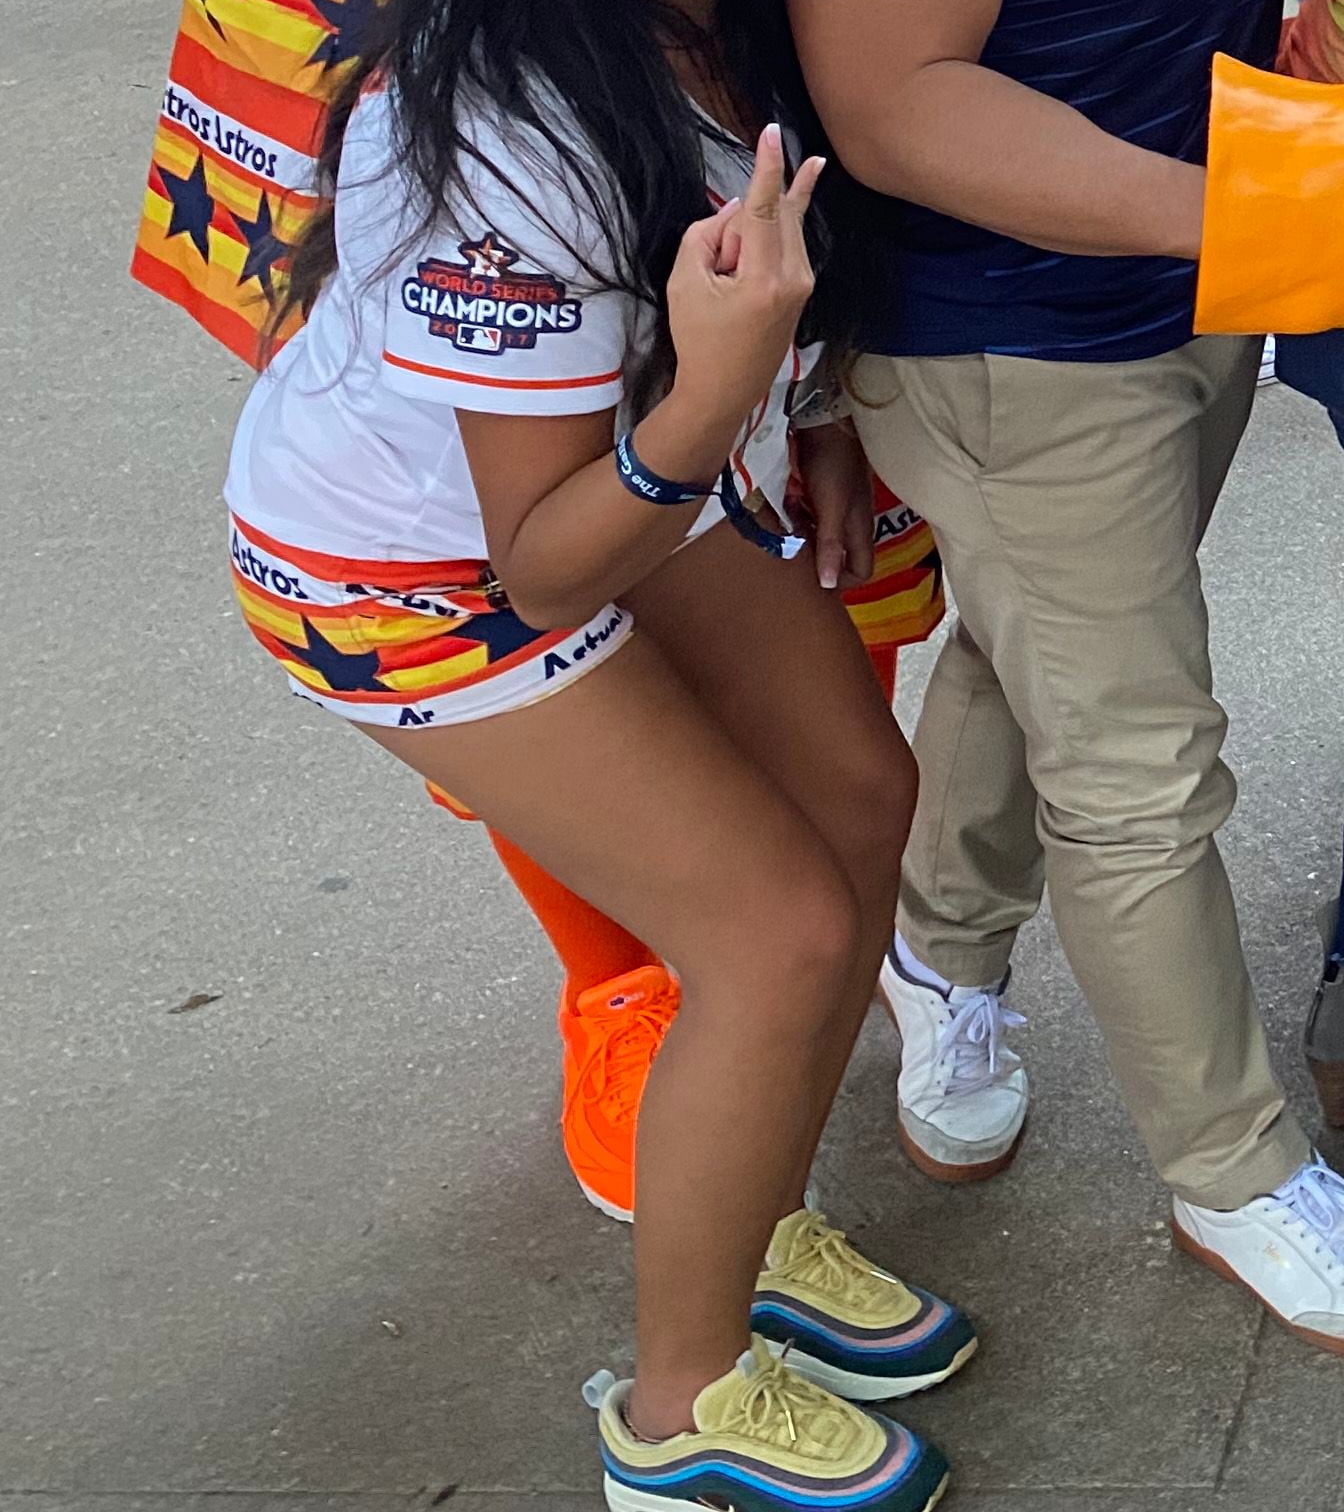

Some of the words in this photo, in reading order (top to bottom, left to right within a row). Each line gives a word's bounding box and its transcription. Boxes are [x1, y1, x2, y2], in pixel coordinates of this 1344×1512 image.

[162, 88, 211, 141] tros
[403, 281, 577, 329] CHAMPIONS
[420, 270, 487, 296] WORLD
[490, 281, 558, 302] SERIES
[631, 474, 661, 498] The
